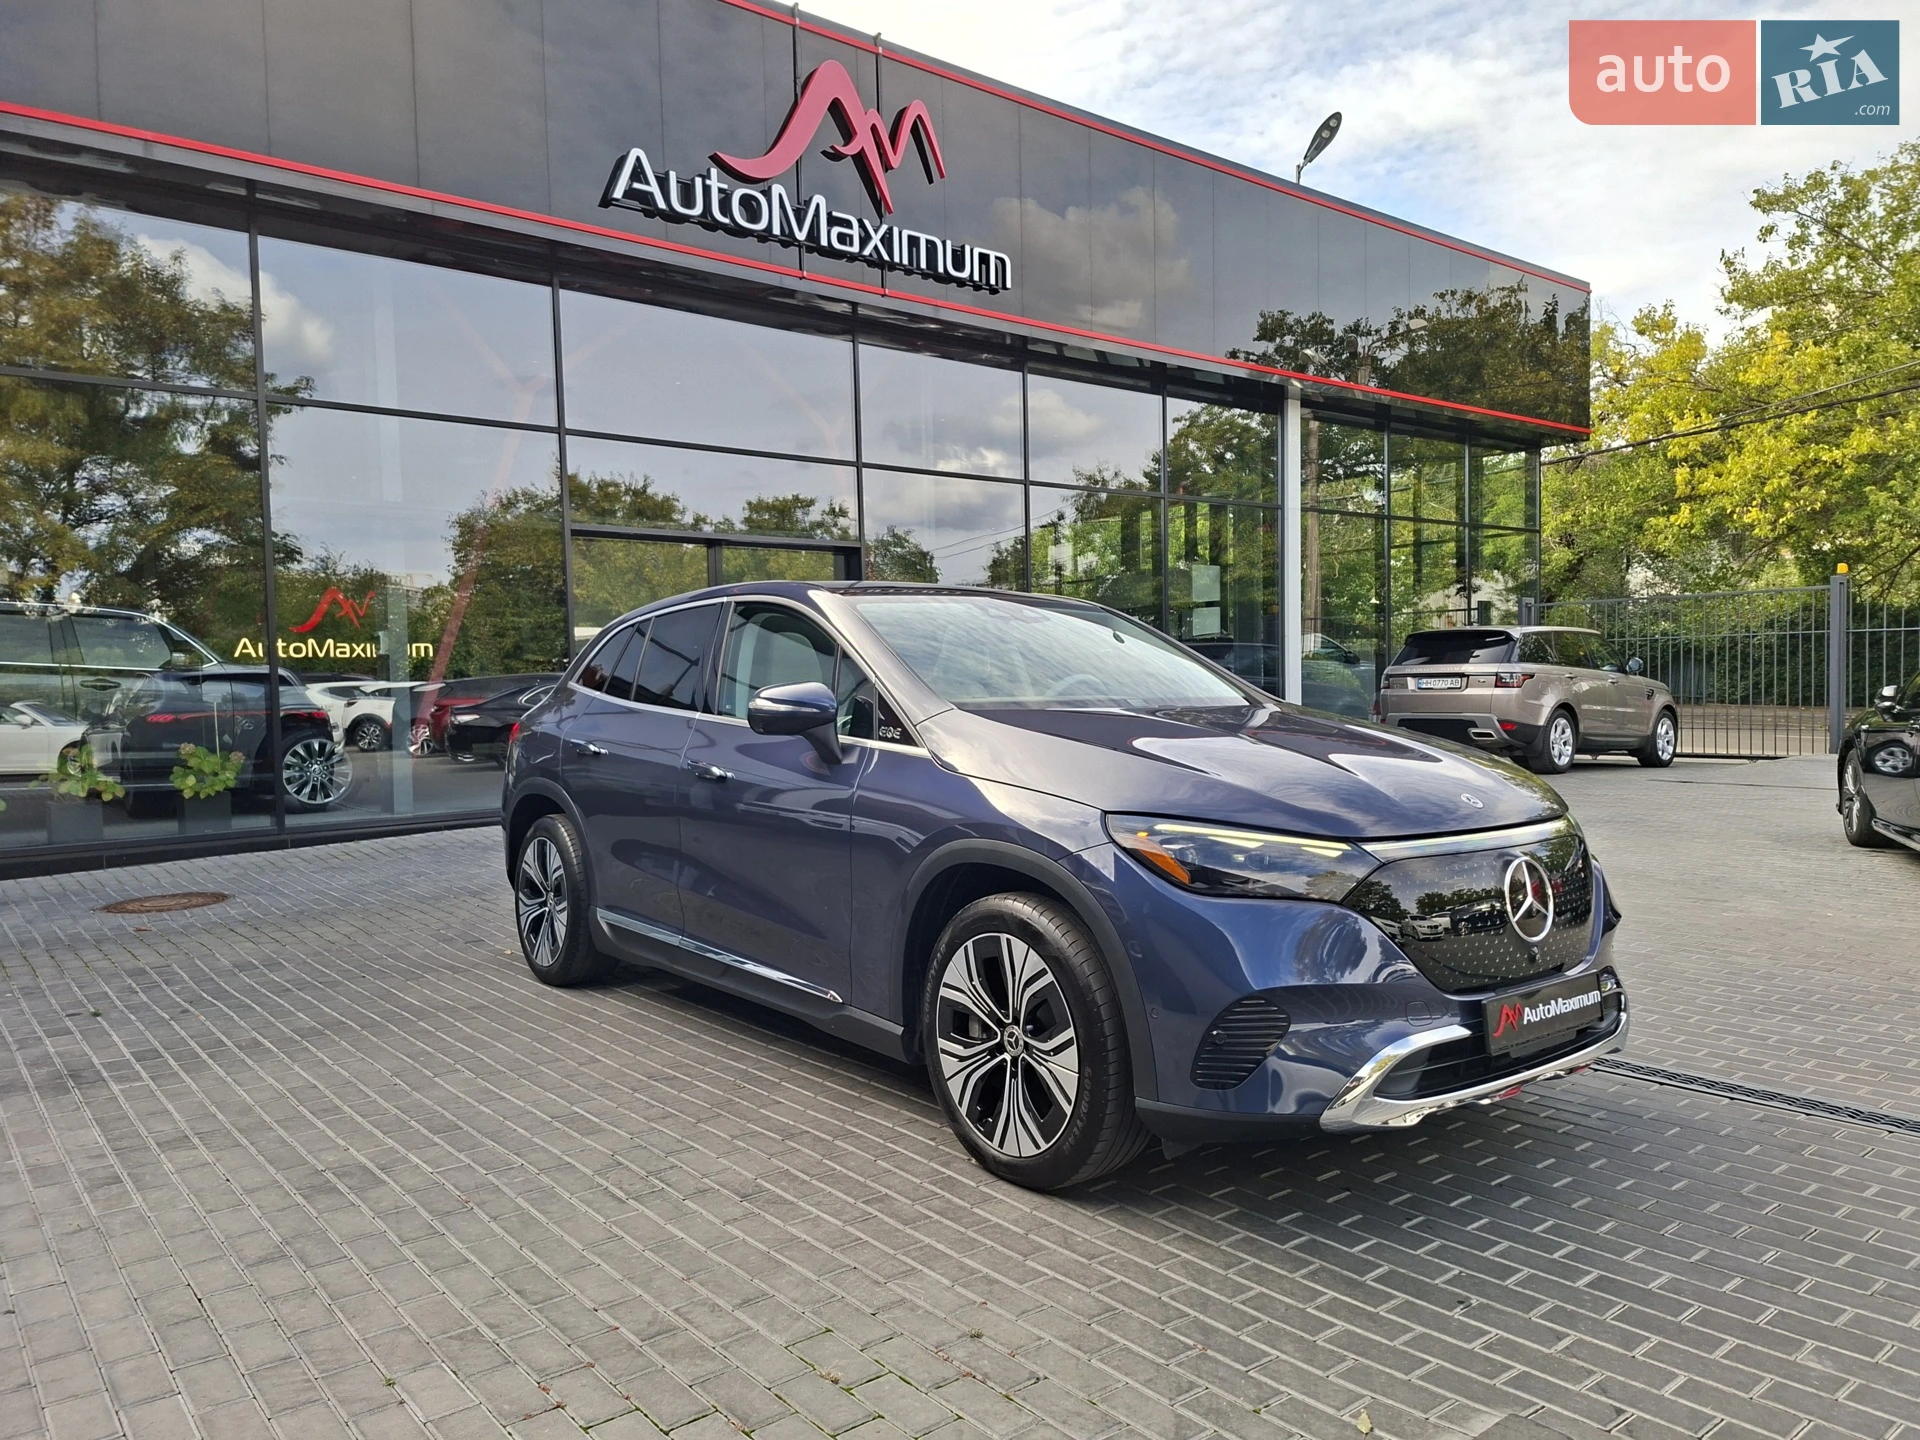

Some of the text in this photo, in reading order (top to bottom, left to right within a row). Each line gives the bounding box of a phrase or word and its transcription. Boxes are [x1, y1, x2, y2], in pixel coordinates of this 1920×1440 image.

[603, 147, 1012, 291] AutoMaximum
[233, 637, 434, 658] AtoMaxim
[1432, 678, 1449, 687] 0770
[879, 726, 902, 739] EQE
[1523, 990, 1601, 1025] AutoMaximum
